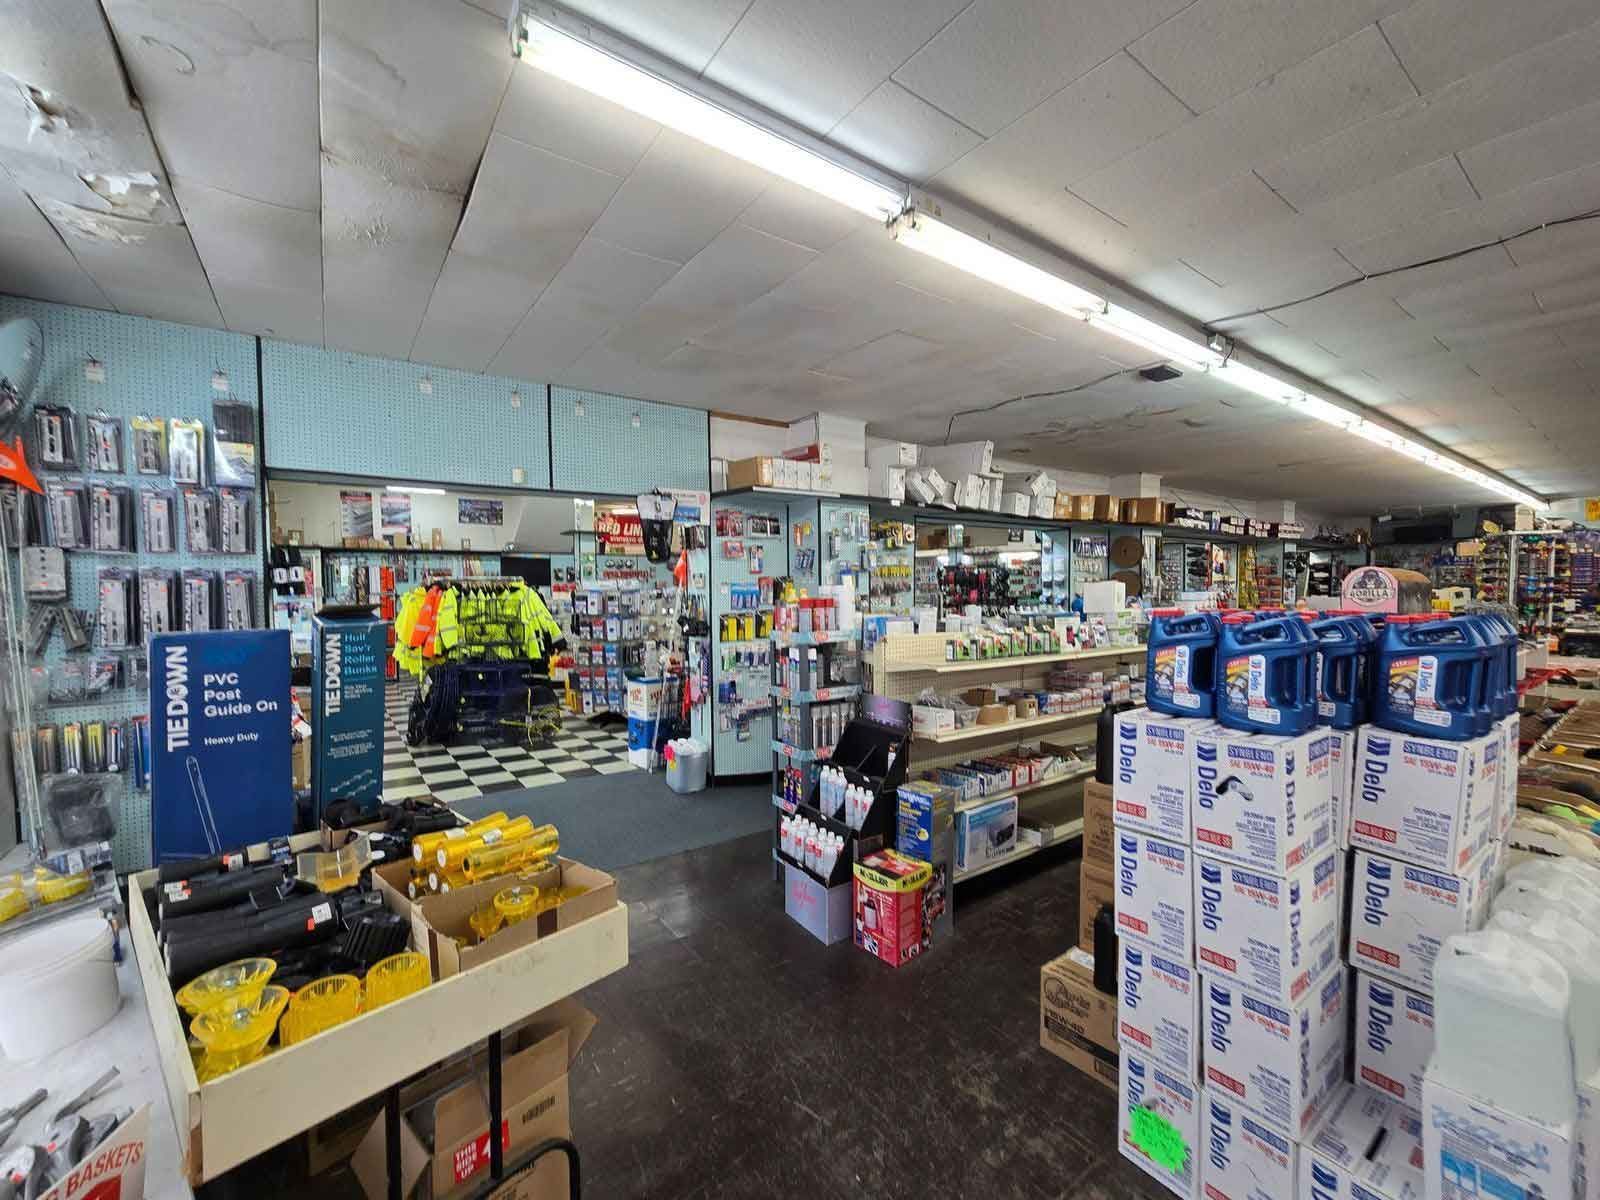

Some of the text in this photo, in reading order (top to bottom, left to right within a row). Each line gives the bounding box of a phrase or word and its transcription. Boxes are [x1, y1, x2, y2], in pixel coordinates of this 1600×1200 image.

[624, 522, 643, 537] LIN
[345, 632, 366, 642] Hull
[203, 673, 239, 686] PVC
[345, 655, 376, 665] Roller
[203, 687, 242, 702] Post
[203, 700, 278, 718] Guide On
[203, 731, 259, 747] Heavy Duty
[1119, 744, 1137, 784] Delo
[1362, 759, 1388, 805] Delo
[1198, 766, 1219, 809] Delo
[1121, 856, 1138, 897] Delo
[1201, 887, 1223, 931] Delo
[1364, 882, 1389, 928] Delo
[1124, 967, 1142, 1010] Delo
[1210, 1006, 1233, 1053] Delo
[1367, 1004, 1393, 1053] Delo
[1210, 1122, 1231, 1170] Delo
[66, 1141, 144, 1197] BASKETS
[461, 1164, 475, 1179] UP
